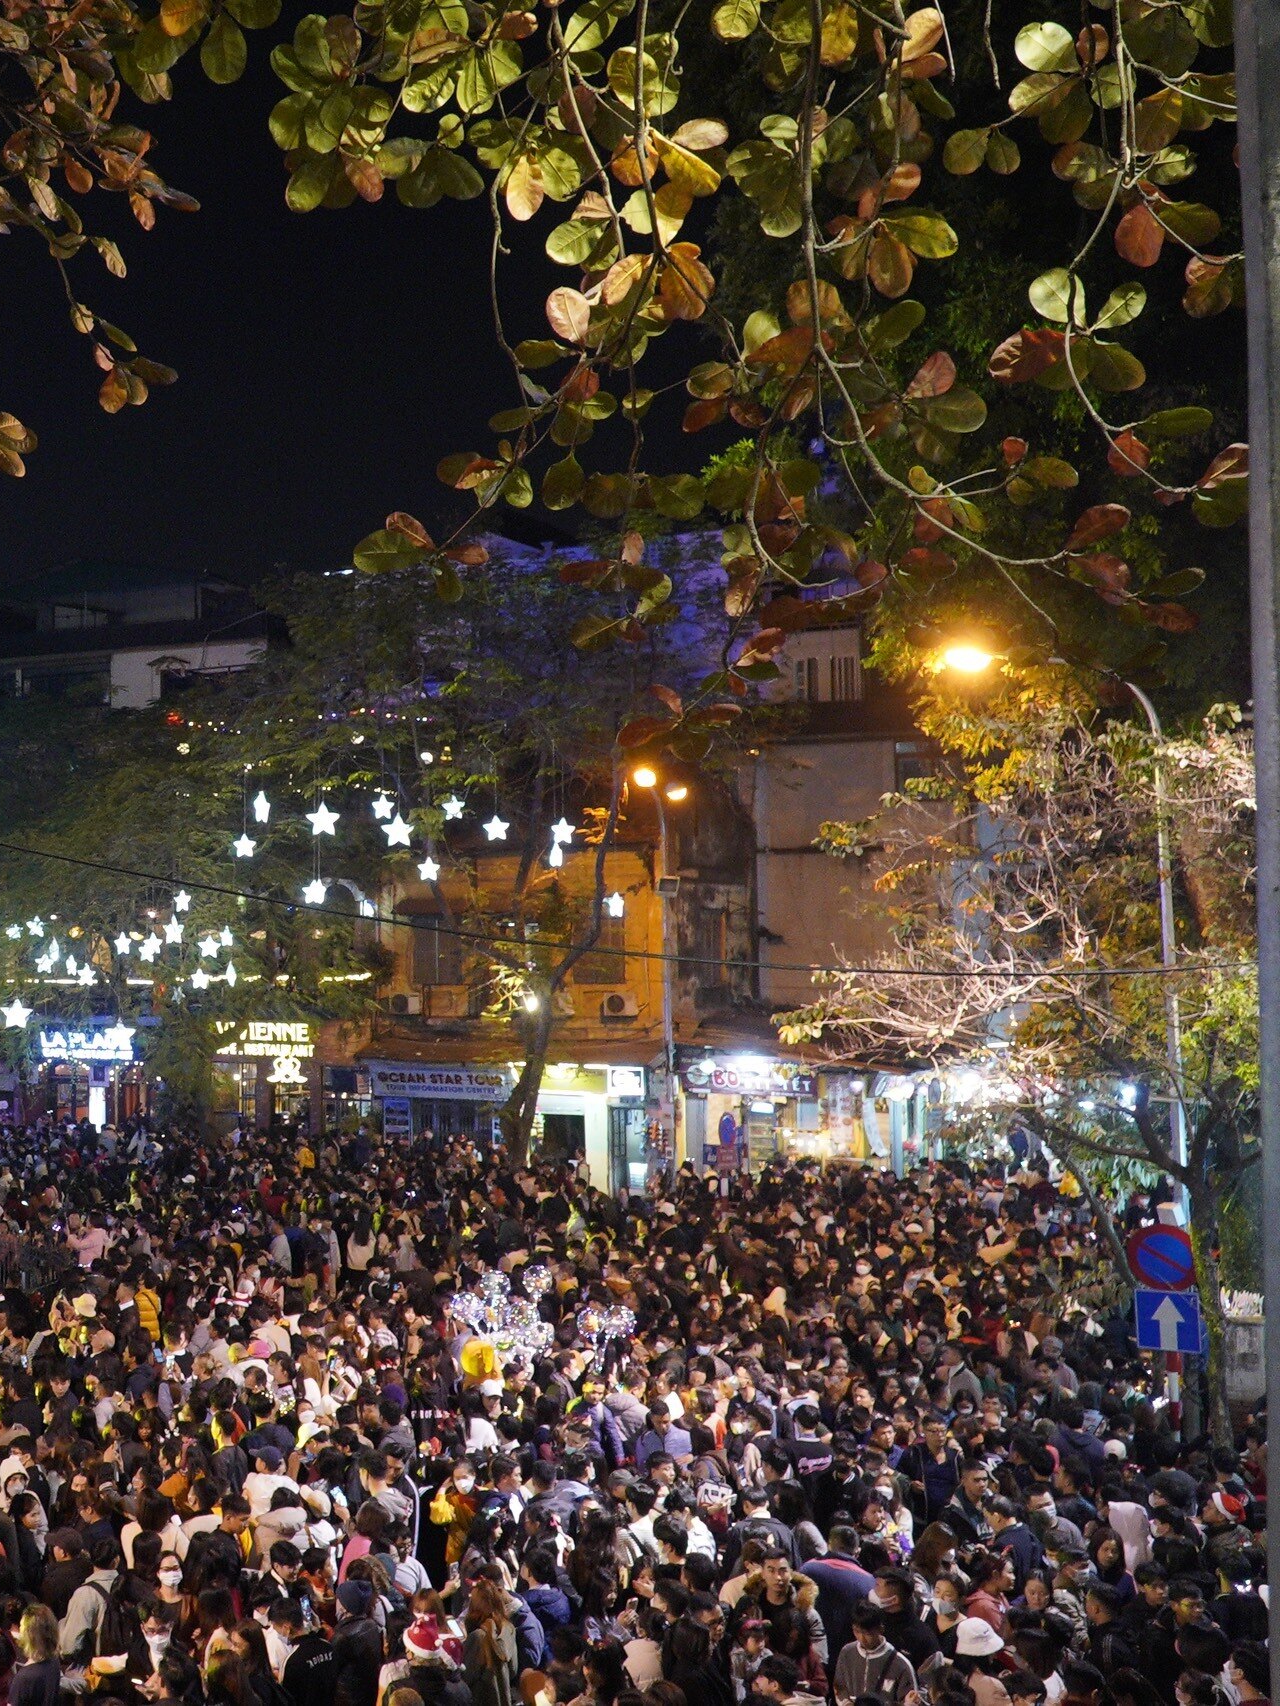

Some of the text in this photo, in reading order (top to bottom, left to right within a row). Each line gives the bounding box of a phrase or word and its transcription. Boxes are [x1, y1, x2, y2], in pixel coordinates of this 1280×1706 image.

[39, 1031, 133, 1050] LA PLA
[378, 1071, 426, 1083] OCEAN
[429, 1074, 462, 1085] STAR
